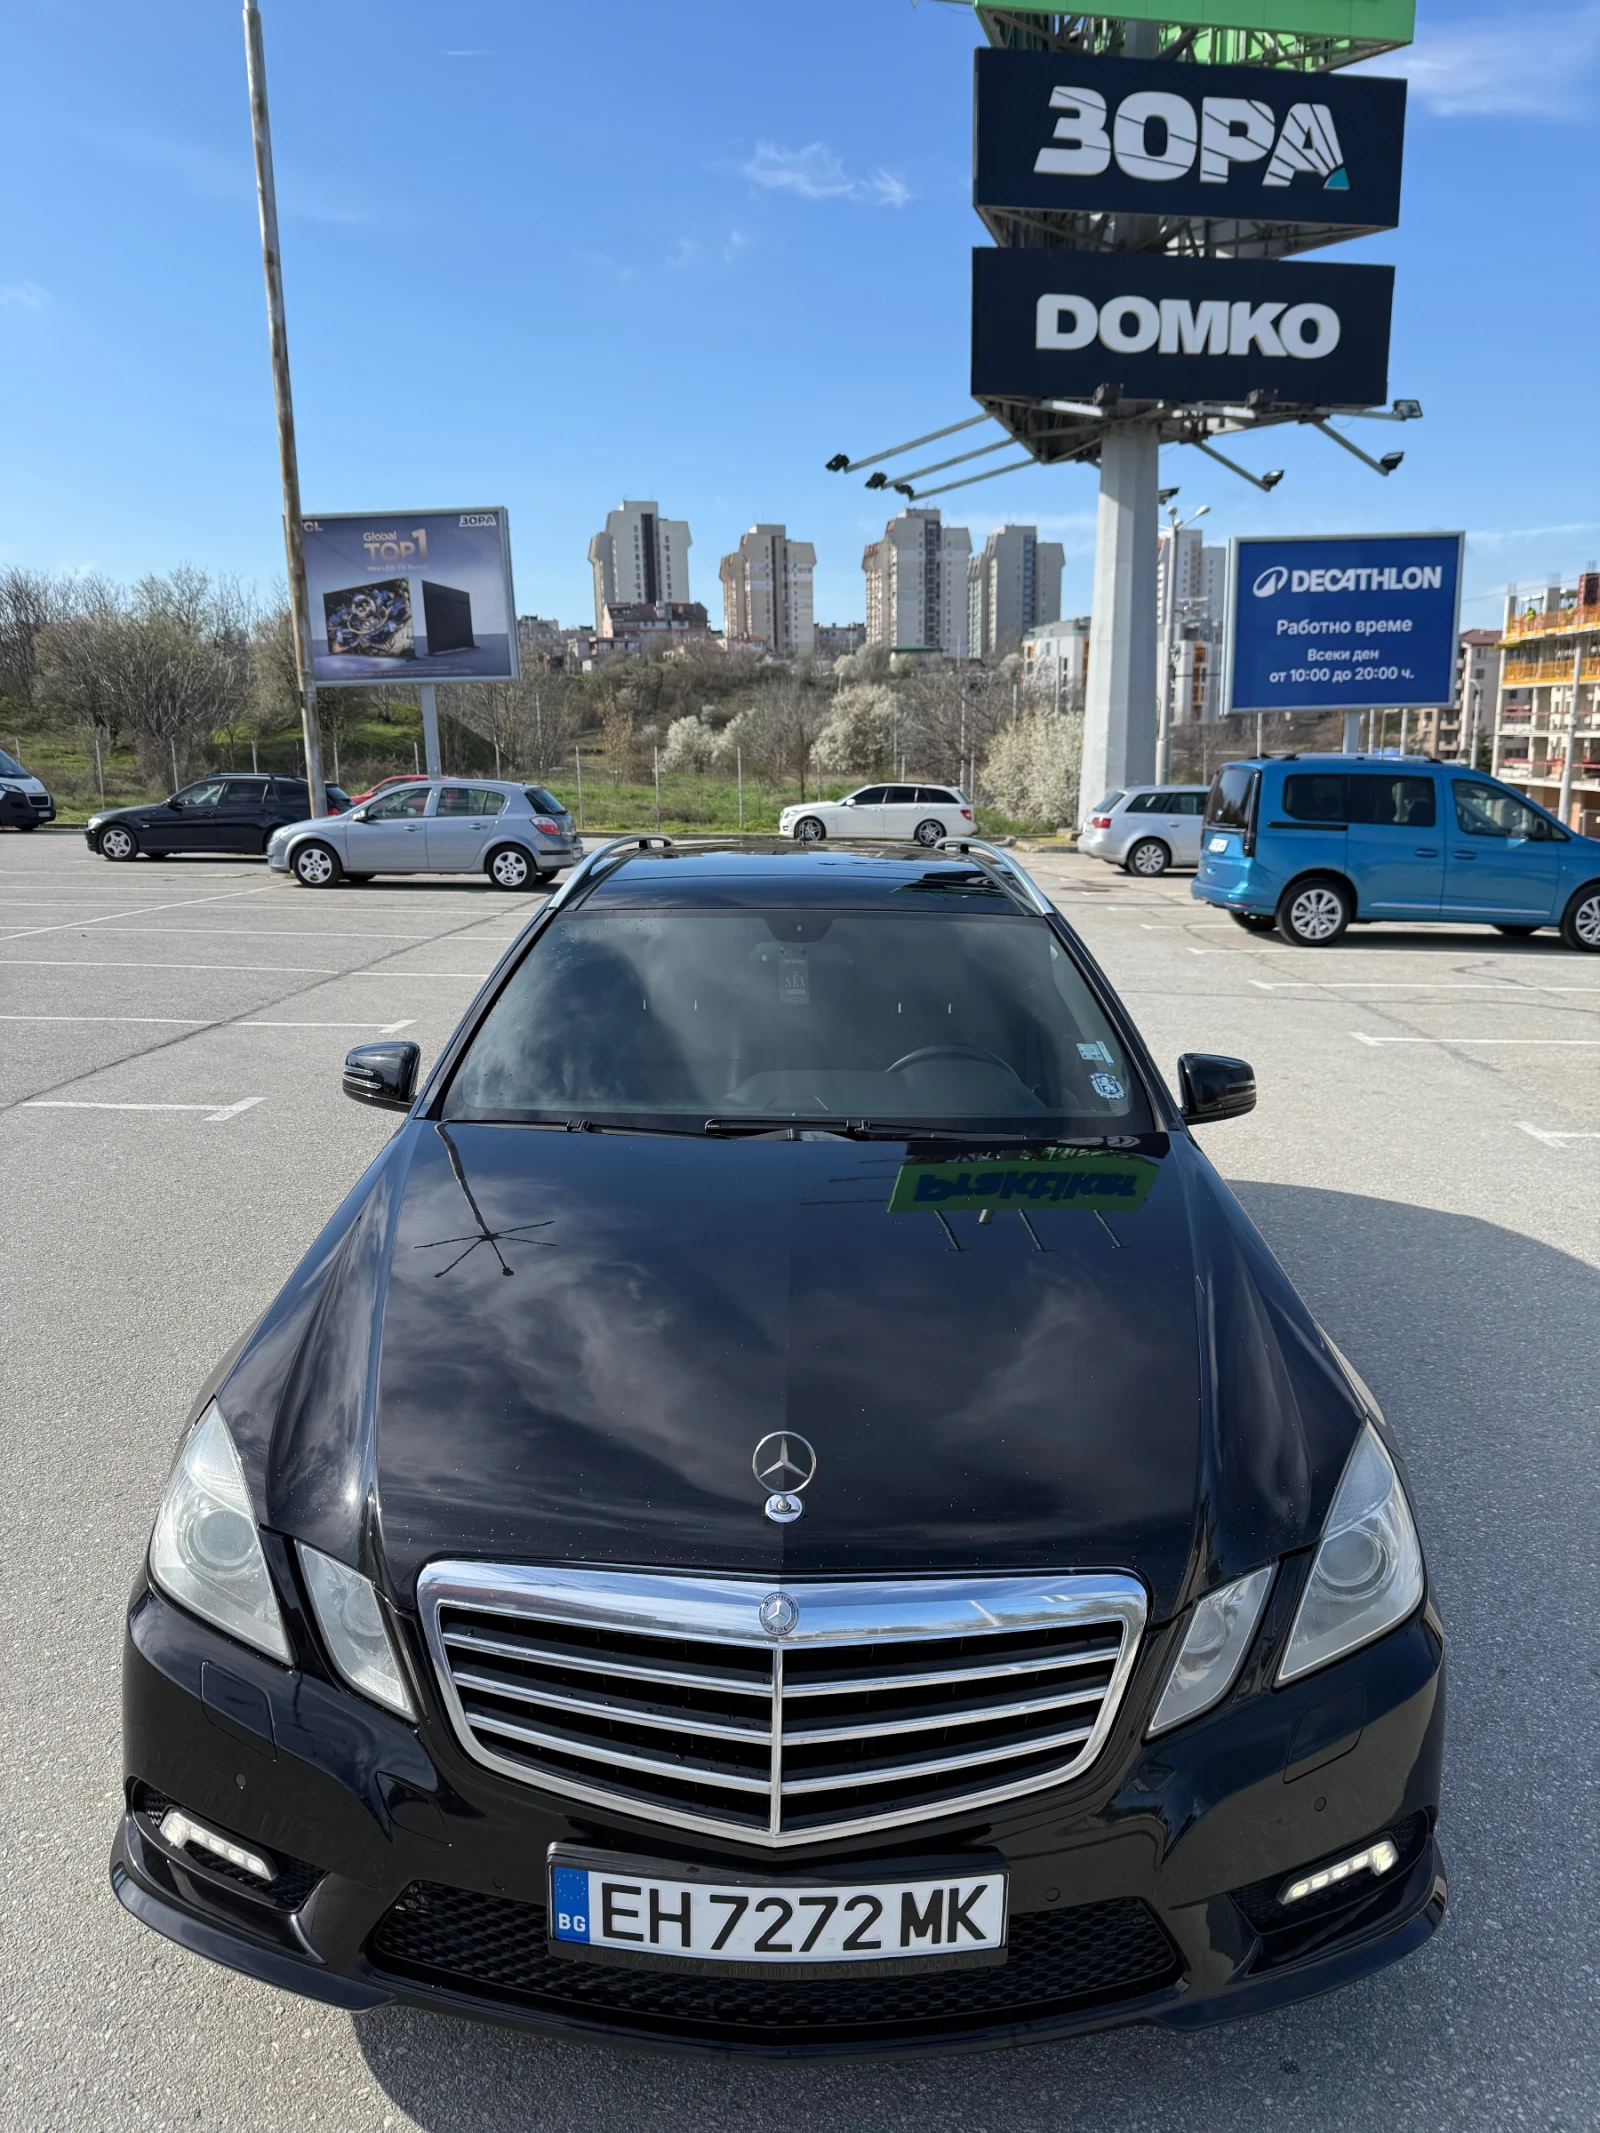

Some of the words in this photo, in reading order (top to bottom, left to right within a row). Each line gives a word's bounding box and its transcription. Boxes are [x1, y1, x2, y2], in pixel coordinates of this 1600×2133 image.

[1033, 85, 1350, 190] ЗОРА
[1036, 293, 1341, 359] DOMKO
[300, 520, 323, 532] CL
[460, 514, 496, 527] ЗОРА
[363, 531, 397, 542] Global
[382, 564, 396, 572] LED
[397, 563, 407, 571] TV
[1291, 566, 1442, 593] DECATHLON
[1276, 619, 1351, 635] Работно
[1355, 619, 1413, 636] време
[1307, 649, 1350, 661] Всеки
[1352, 649, 1379, 662] ден
[1269, 671, 1286, 683] от
[1290, 668, 1330, 682] 10:00
[1332, 670, 1352, 684] до
[1355, 667, 1398, 680] 20:00
[1401, 668, 1415, 679] ч.
[558, 1913, 586, 1932] BG
[601, 1882, 692, 1947] EH
[709, 1894, 883, 1953] 7272
[901, 1884, 988, 1947] MK
